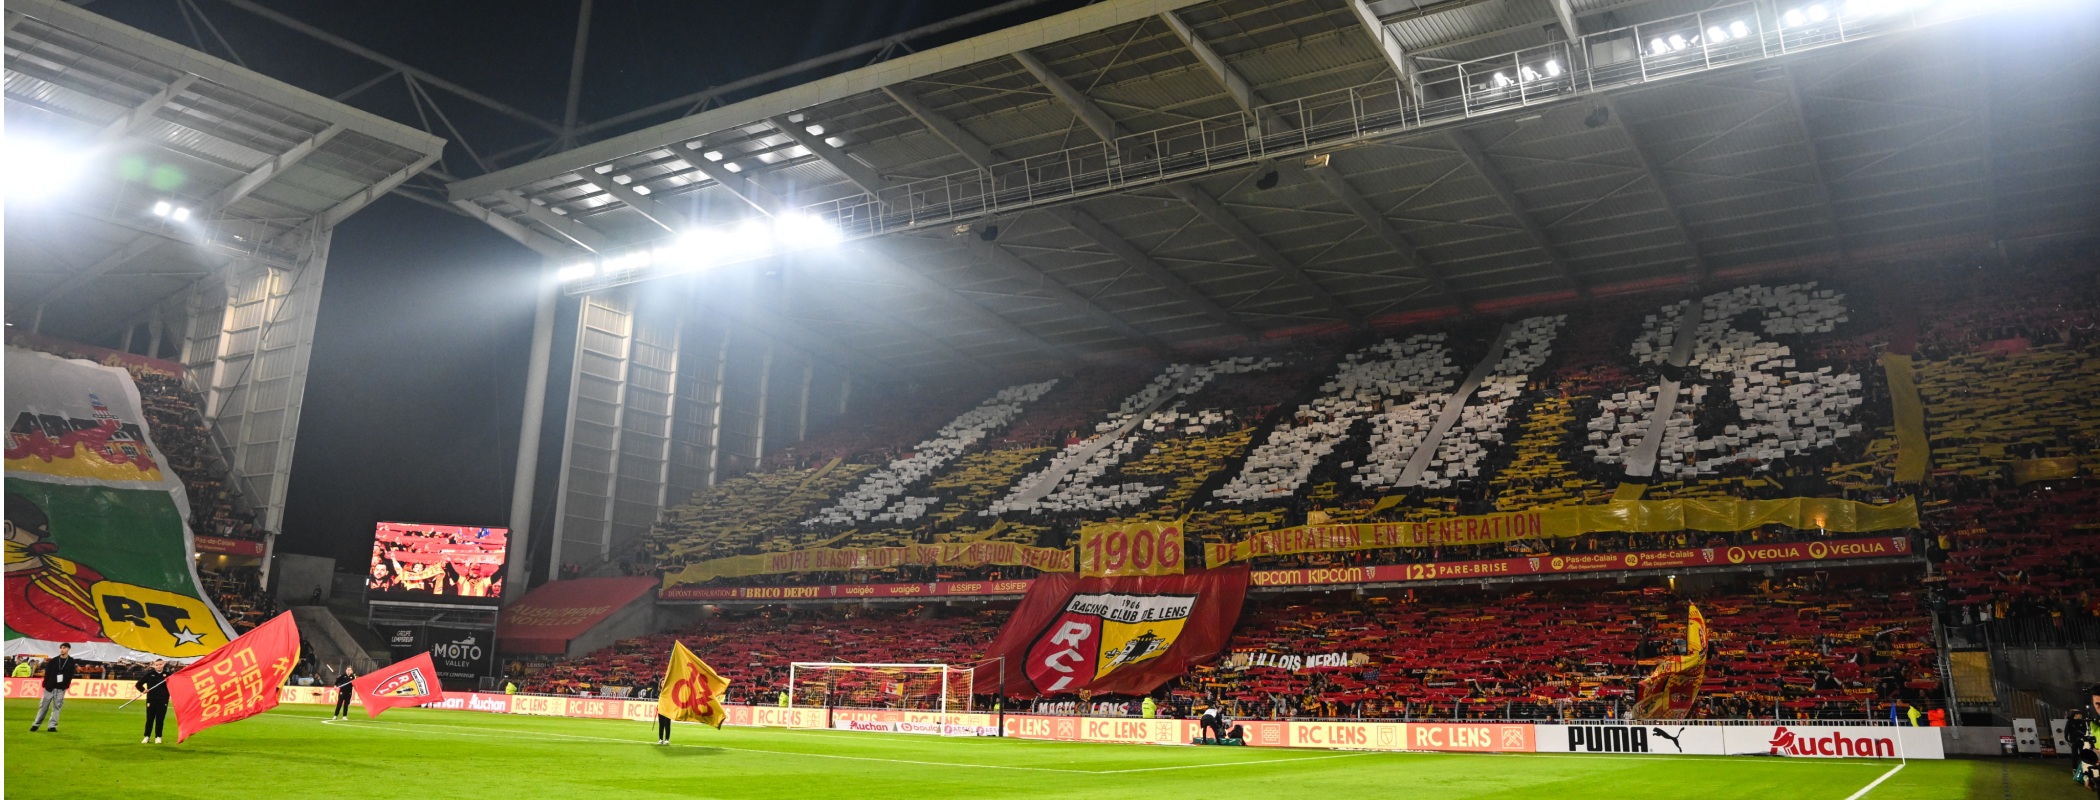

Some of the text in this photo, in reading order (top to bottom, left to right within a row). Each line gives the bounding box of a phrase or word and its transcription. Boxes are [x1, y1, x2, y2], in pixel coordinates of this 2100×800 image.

[1216, 512, 1542, 563] DE GENERATION EN GENERATION
[1086, 527, 1181, 572] 1906
[1748, 547, 1800, 560] VEOLIA
[1830, 542, 1885, 555] VEOLIA
[772, 542, 1071, 572] NOTRE BLASON FLOTTE SUR LA REGION DEPUIS
[1250, 571, 1301, 585] KIPCOM
[1308, 567, 1362, 583] KIPCOM
[1406, 562, 1508, 580] 123 PARE-BRISE
[746, 587, 820, 598] BRICO DEPOT
[846, 585, 875, 596] waigéo
[890, 584, 921, 595] waigéo
[1071, 600, 1188, 622] RACING CLUB DE LENS
[434, 643, 482, 661] MOTO
[445, 659, 470, 668] VALLEY
[83, 682, 118, 697] LENS
[281, 688, 296, 702] NS
[329, 689, 339, 703] R
[468, 693, 506, 711] Auchan
[515, 698, 548, 712] RC LENS
[569, 701, 604, 715] RC LENS
[1090, 701, 1129, 716] LENS
[628, 703, 641, 717] RC
[758, 709, 773, 724] RC
[849, 721, 888, 732] Auchan
[1019, 718, 1050, 736] LENS
[1089, 720, 1147, 739] RC LENS
[1298, 725, 1367, 745] RC LENS
[1416, 727, 1492, 747] RC LENS
[1568, 726, 1648, 752] PUMA
[1769, 726, 1895, 757] Auchan
